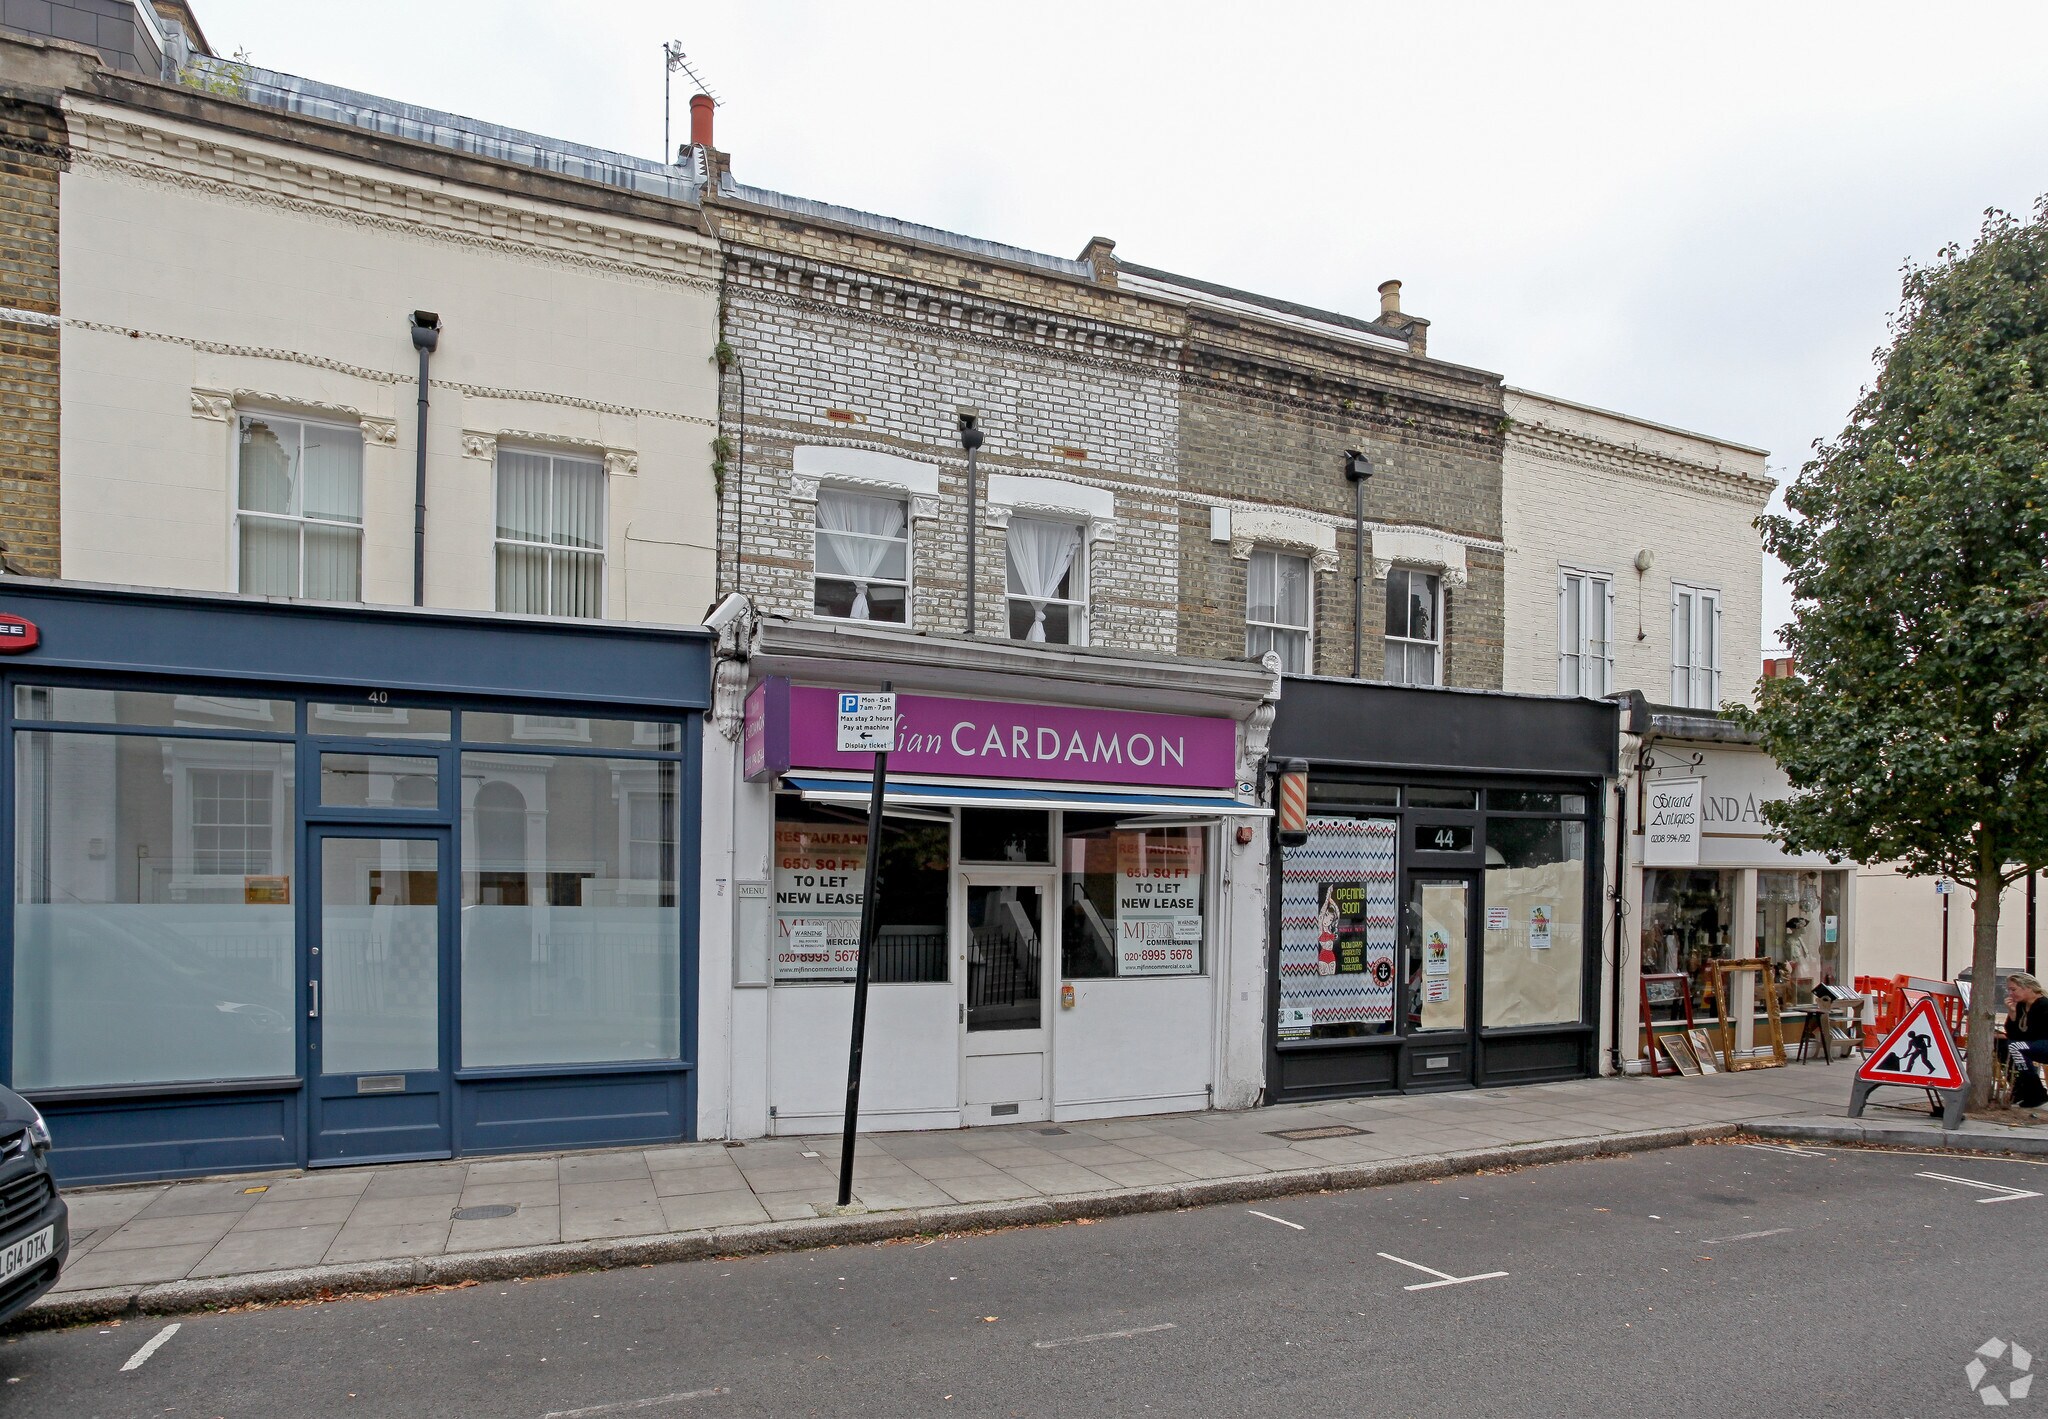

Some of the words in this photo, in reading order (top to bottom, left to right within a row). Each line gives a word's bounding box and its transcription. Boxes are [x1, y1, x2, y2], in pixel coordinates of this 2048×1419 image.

[368, 690, 388, 703] 40
[951, 721, 1184, 768] CARDAMON
[1653, 793, 1693, 809] Strand
[1651, 811, 1695, 828] Antiques
[775, 831, 868, 845] RESTAURANT
[1434, 829, 1454, 847] 44
[1651, 834, 1666, 843] 0208
[783, 858, 810, 869] 650
[815, 859, 836, 871] SQ
[841, 860, 860, 871] FT
[1126, 867, 1149, 878] 650
[1153, 868, 1171, 879] SQ
[1174, 868, 1190, 878] FT
[794, 876, 815, 887] TO
[820, 876, 848, 887] LET
[741, 887, 765, 895] MENU
[1136, 883, 1153, 893] TO
[1157, 883, 1181, 893] LET
[1336, 887, 1365, 900] OPENING
[776, 892, 811, 904] NEW
[816, 893, 864, 904] LEASE
[1121, 898, 1150, 909] NEW
[1154, 898, 1194, 909] LEASE
[1342, 902, 1360, 914] SOON
[795, 930, 823, 938] WARNING
[835, 950, 860, 962] 5678
[1170, 949, 1193, 960] 5678
[1344, 956, 1359, 964] COLOUR
[0, 1244, 23, 1278] LG14
[26, 1232, 47, 1263] DTK
